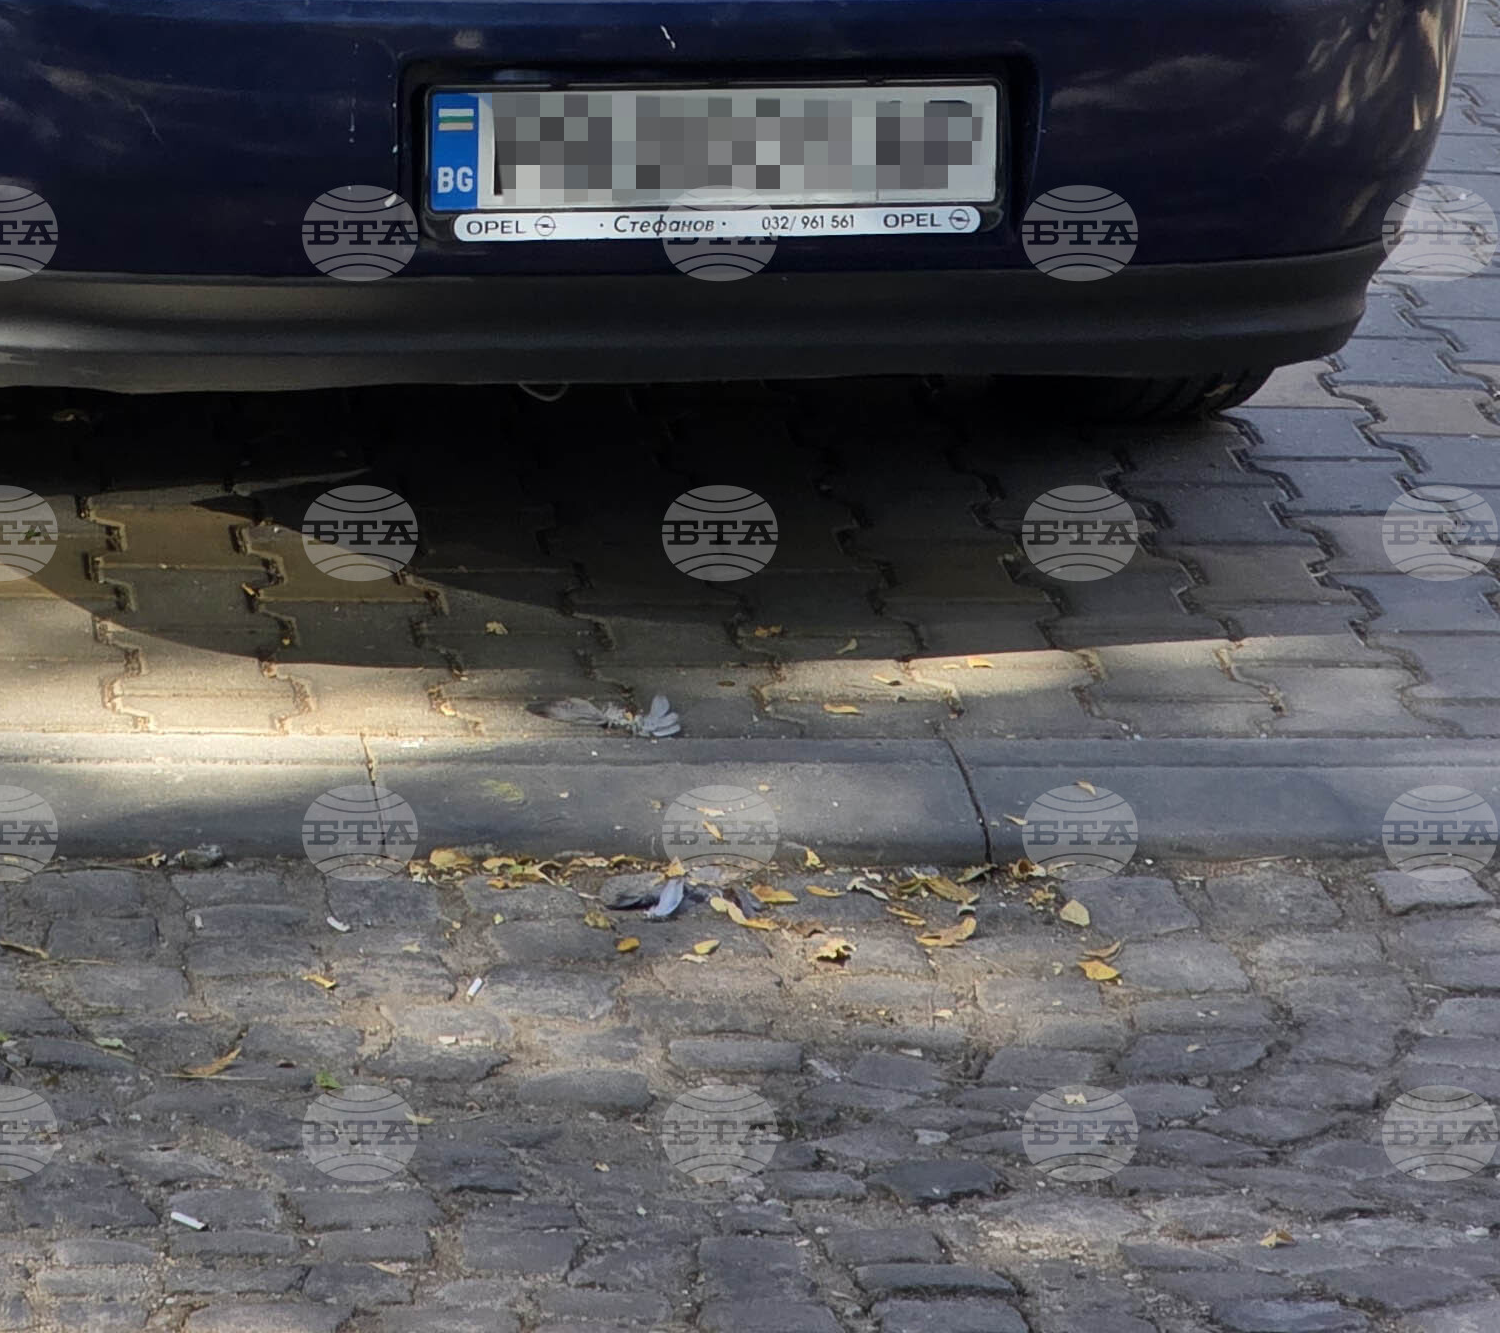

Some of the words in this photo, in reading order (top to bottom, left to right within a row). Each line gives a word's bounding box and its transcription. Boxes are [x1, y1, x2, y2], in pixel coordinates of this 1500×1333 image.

[436, 165, 475, 195] BG
[466, 219, 527, 237] OPEL
[612, 214, 716, 237] Стефанов
[801, 214, 825, 232] 961
[827, 214, 856, 231] 561
[883, 211, 944, 230] OPEL
